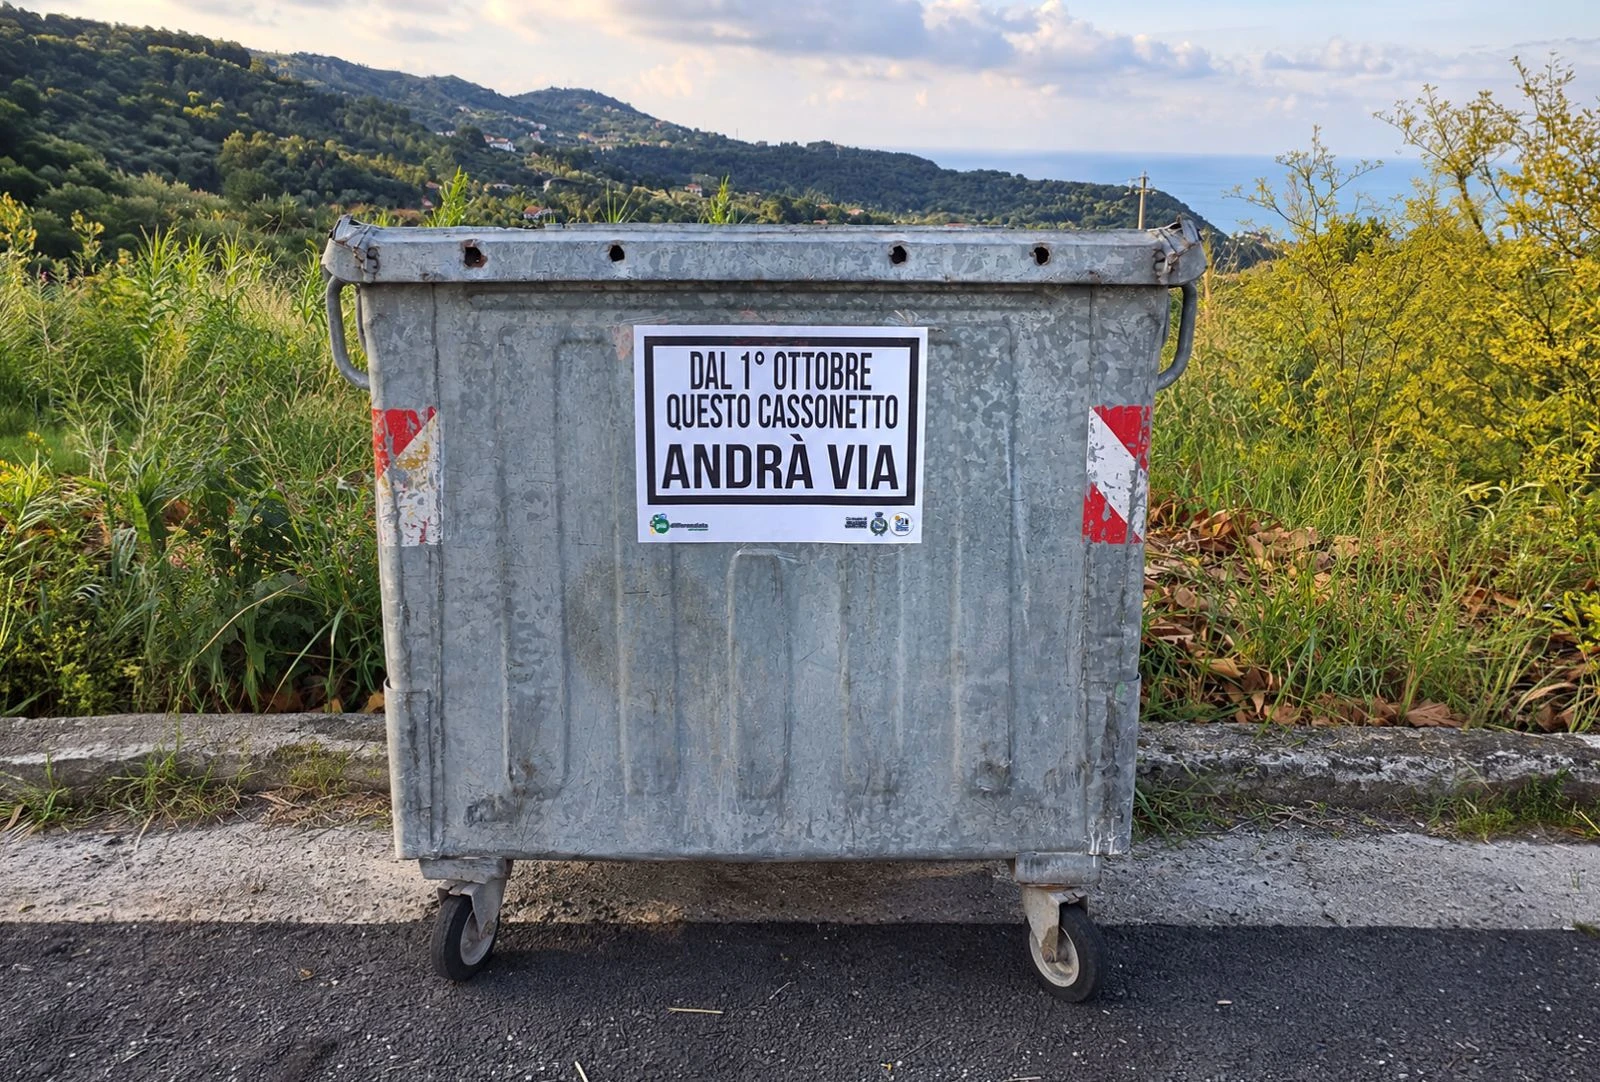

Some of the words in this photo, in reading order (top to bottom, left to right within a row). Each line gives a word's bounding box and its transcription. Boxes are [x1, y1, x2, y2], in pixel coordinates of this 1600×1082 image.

[690, 351, 732, 390] DAL
[741, 351, 764, 390] 1°
[774, 351, 872, 391] OTTOBRE
[667, 393, 750, 430] QUESTO
[759, 394, 898, 429] CASSONETTO
[662, 433, 813, 489] ANDRÀ
[828, 444, 899, 489] VIA
